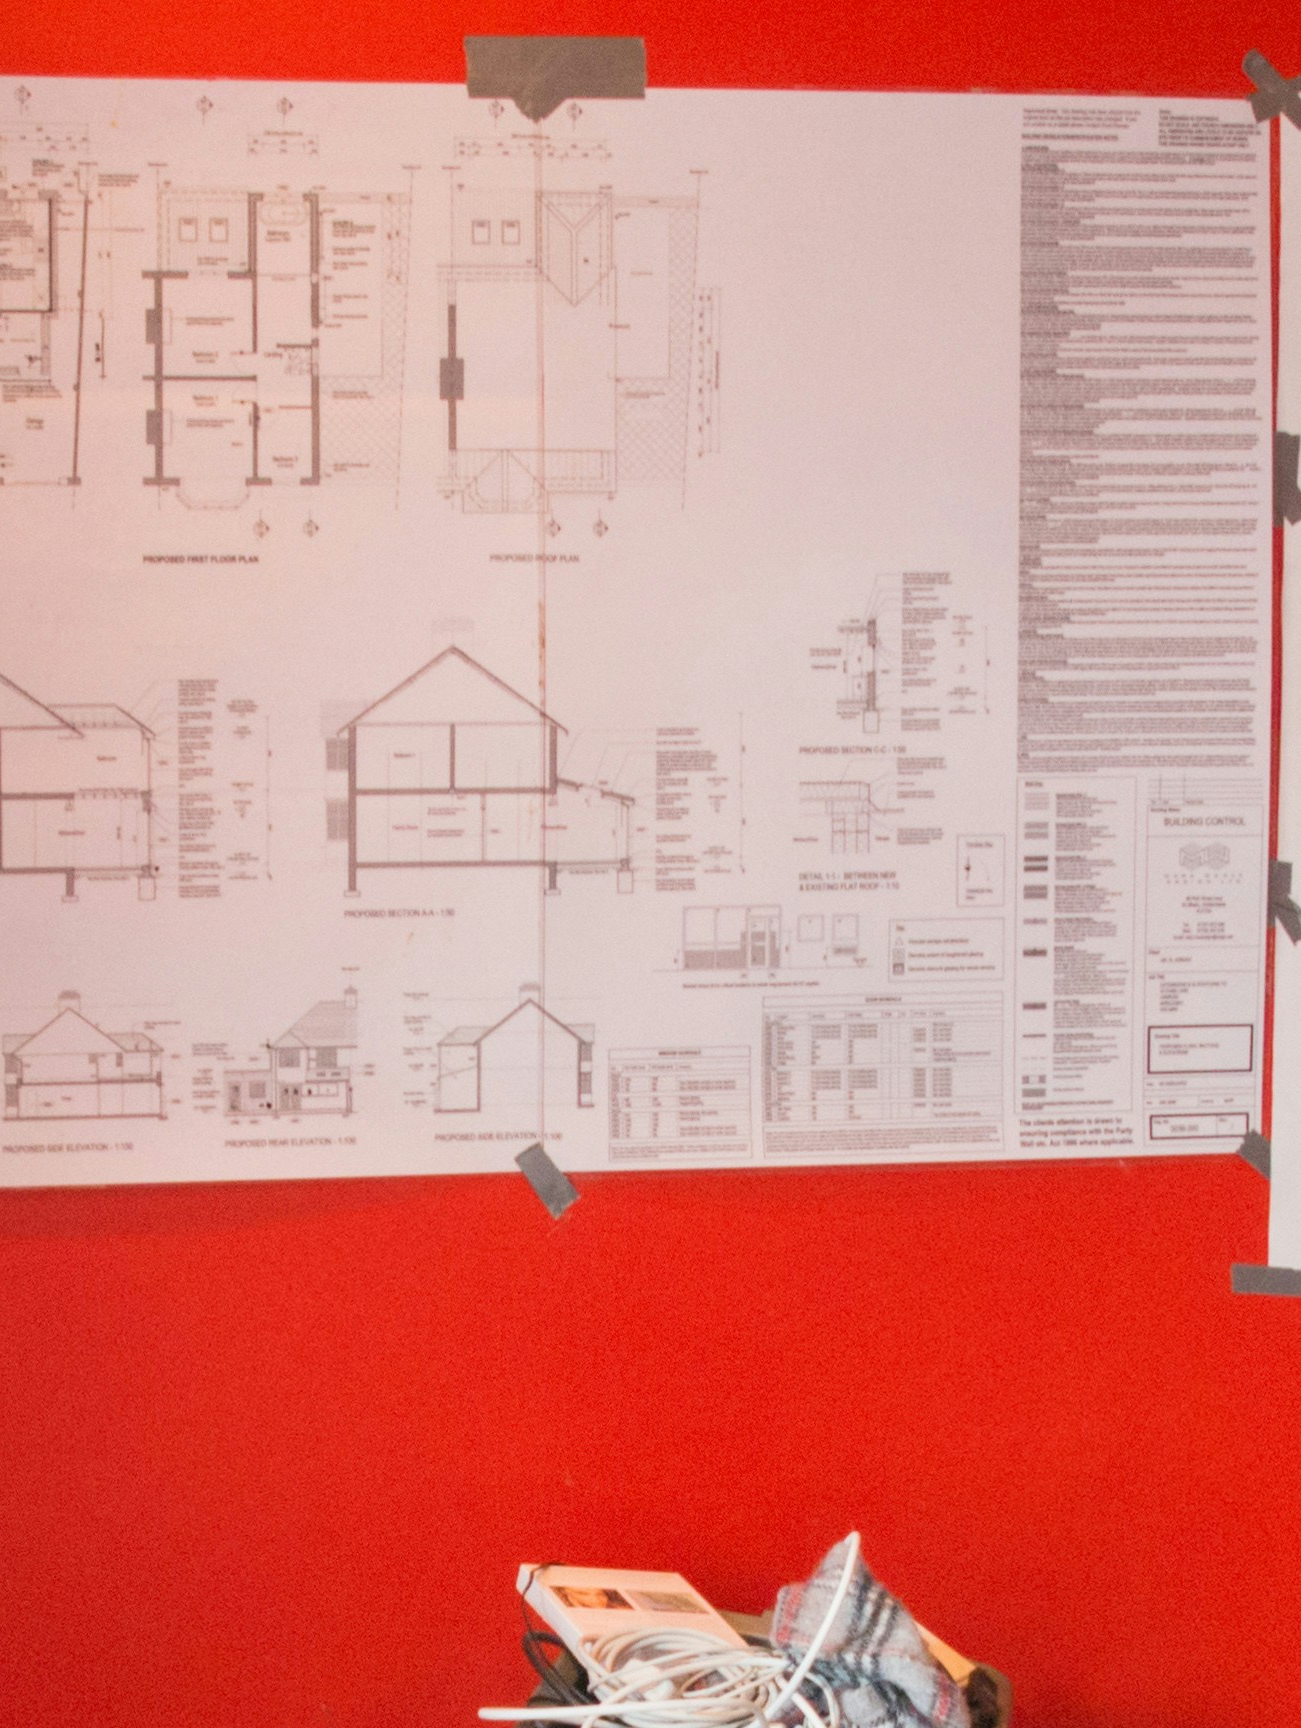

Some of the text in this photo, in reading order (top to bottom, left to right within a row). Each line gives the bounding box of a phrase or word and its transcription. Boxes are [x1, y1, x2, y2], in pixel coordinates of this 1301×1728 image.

[143, 555, 259, 564] PROPOSED FIRST FLOOR PLAN
[490, 554, 534, 563] PROPOSED
[559, 554, 580, 563] PLAN
[799, 745, 839, 754] PROPOSED
[841, 745, 872, 754] SECTION
[1164, 816, 1246, 827] BUILDING CONTROL
[799, 871, 822, 880] DETAIL
[844, 871, 878, 880] BETWEEN
[880, 871, 896, 880] NEW
[806, 882, 839, 891] EXISTING
[860, 882, 879, 891] ROOF
[344, 909, 386, 918] PROPOSED
[388, 909, 420, 918] SECTION
[1020, 1118, 1032, 1126] The
[1056, 1118, 1084, 1126] attention
[1020, 1126, 1132, 1138] ensuring compliance with the Party
[435, 1133, 476, 1142] PROPOSED
[478, 1132, 494, 1141] SIDE
[496, 1132, 537, 1140] ELEVATION
[224, 1139, 267, 1148] PROPOSED
[268, 1138, 289, 1148] REAR
[290, 1137, 332, 1146] ELEVATION
[1079, 1138, 1098, 1146] where
[2, 1144, 45, 1154] PROPOSED
[47, 1144, 64, 1152] SIDE
[66, 1143, 108, 1152] ELEVATION
